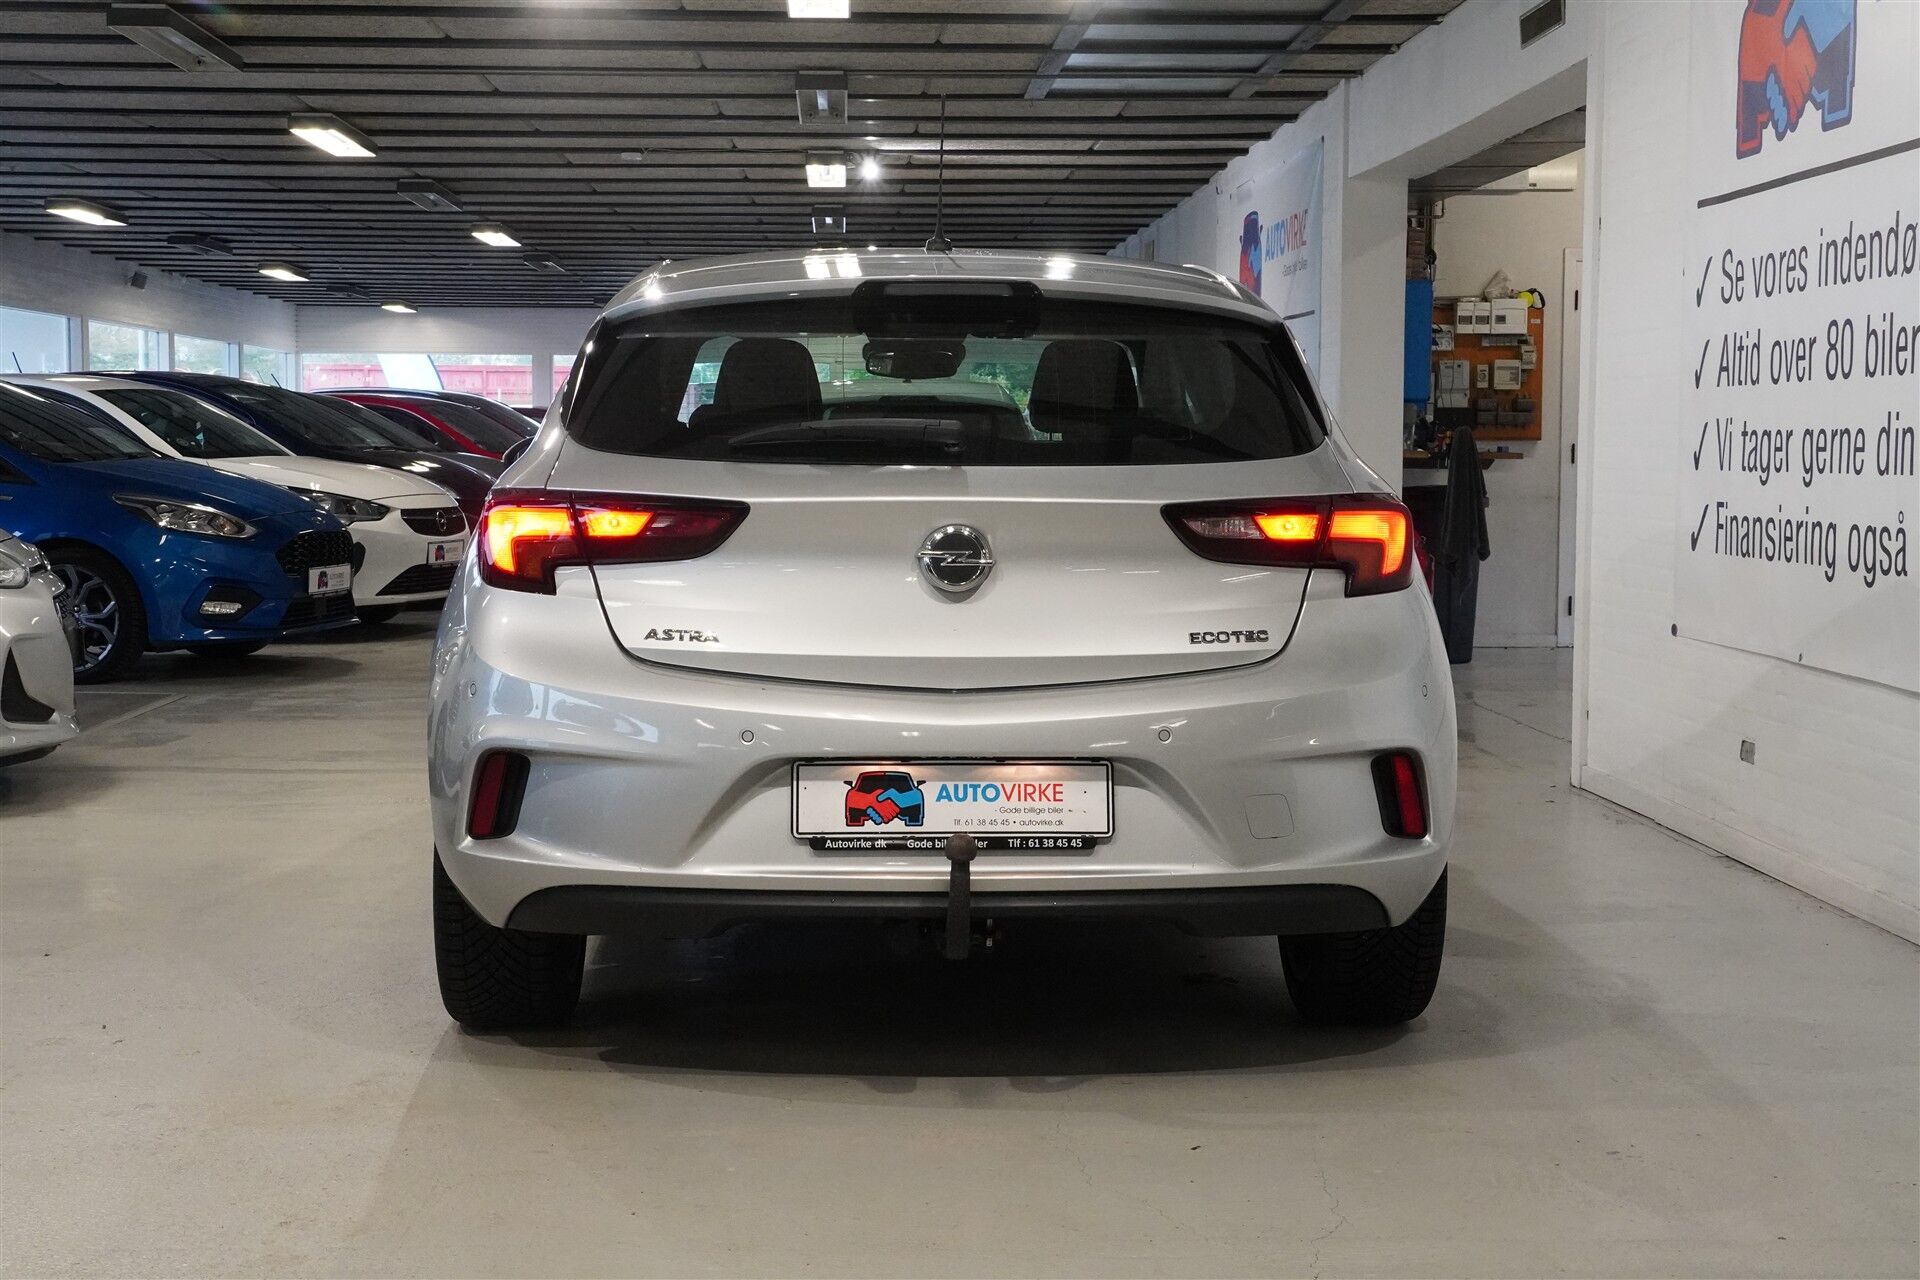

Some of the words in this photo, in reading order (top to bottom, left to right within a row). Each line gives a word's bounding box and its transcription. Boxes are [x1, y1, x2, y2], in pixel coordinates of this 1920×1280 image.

[1720, 248, 1745, 304] Se
[1752, 245, 1808, 298] vores
[1817, 210, 1920, 288] indendø
[1716, 328, 1761, 388] Altid
[1770, 335, 1817, 385] over
[1825, 318, 1854, 381] 80
[1865, 312, 1920, 378] biler
[1716, 417, 1733, 471] Vi
[1741, 420, 1793, 486] tager
[1802, 426, 1865, 488] gerne
[1876, 411, 1915, 476] din
[1715, 501, 1837, 583] Finansiering
[1848, 510, 1908, 588] også
[644, 628, 720, 643] ASTRA
[1189, 629, 1269, 645] ECOTEC
[935, 783, 1064, 803] AUTOVIRKE
[999, 806, 1022, 814] Gode
[1047, 806, 1064, 814] biler
[965, 818, 974, 826] 61
[976, 818, 986, 826] 38
[988, 818, 998, 826] 45
[1000, 818, 1010, 826] 45
[825, 839, 872, 848] Autovirke
[907, 839, 933, 849] Gode
[1028, 838, 1040, 848] 61
[1042, 838, 1054, 848] 38
[1056, 838, 1068, 848] 45
[1070, 838, 1082, 848] 45
